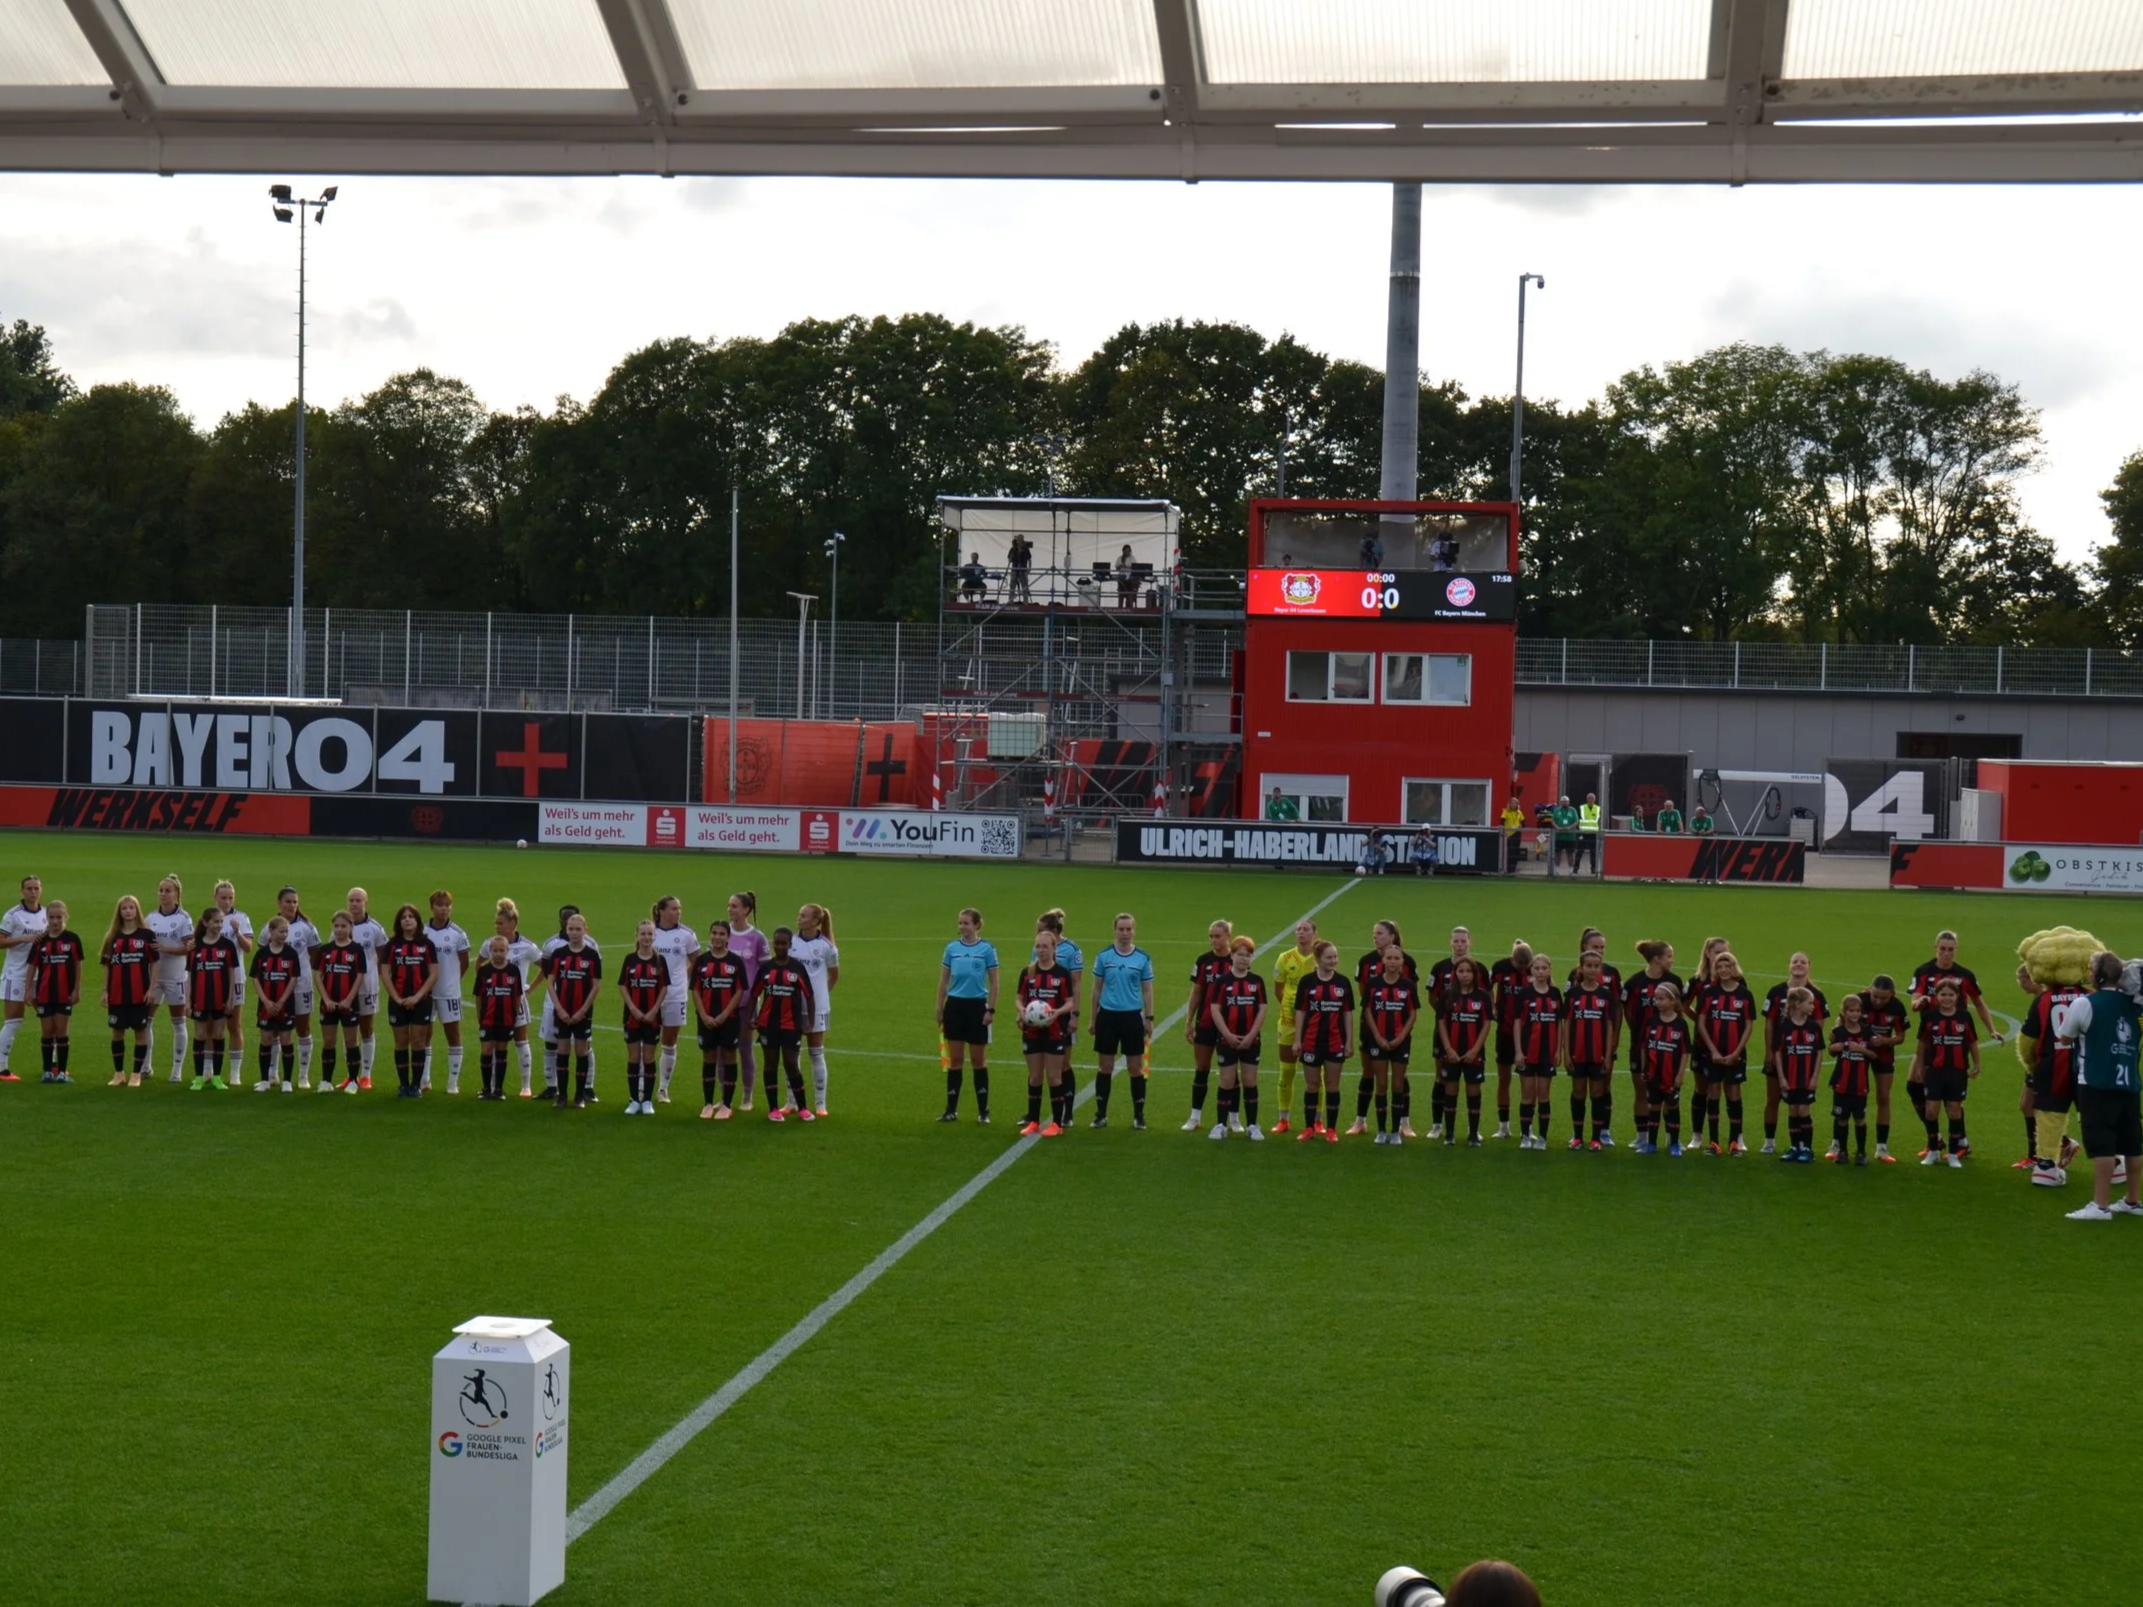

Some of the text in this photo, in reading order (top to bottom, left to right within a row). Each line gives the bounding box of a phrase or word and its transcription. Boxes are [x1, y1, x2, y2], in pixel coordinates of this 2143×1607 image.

[1367, 574, 1395, 583] 00:00
[1492, 575, 1512, 583] 17:58
[1361, 588, 1400, 609] 0:0
[46, 788, 249, 832] WERKSELF
[545, 808, 635, 821] Weil's um mehr
[698, 812, 790, 825] Weil's um mehr
[545, 825, 625, 840] als Geld geht.
[890, 818, 974, 842] YouFin
[698, 830, 780, 844] als Geld geht.
[1380, 834, 1476, 866] STAION
[467, 1434, 526, 1444] GOOGLE PIXEL
[467, 1442, 502, 1451] FRAUEN-
[467, 1452, 518, 1460] BUNDESLIGA
